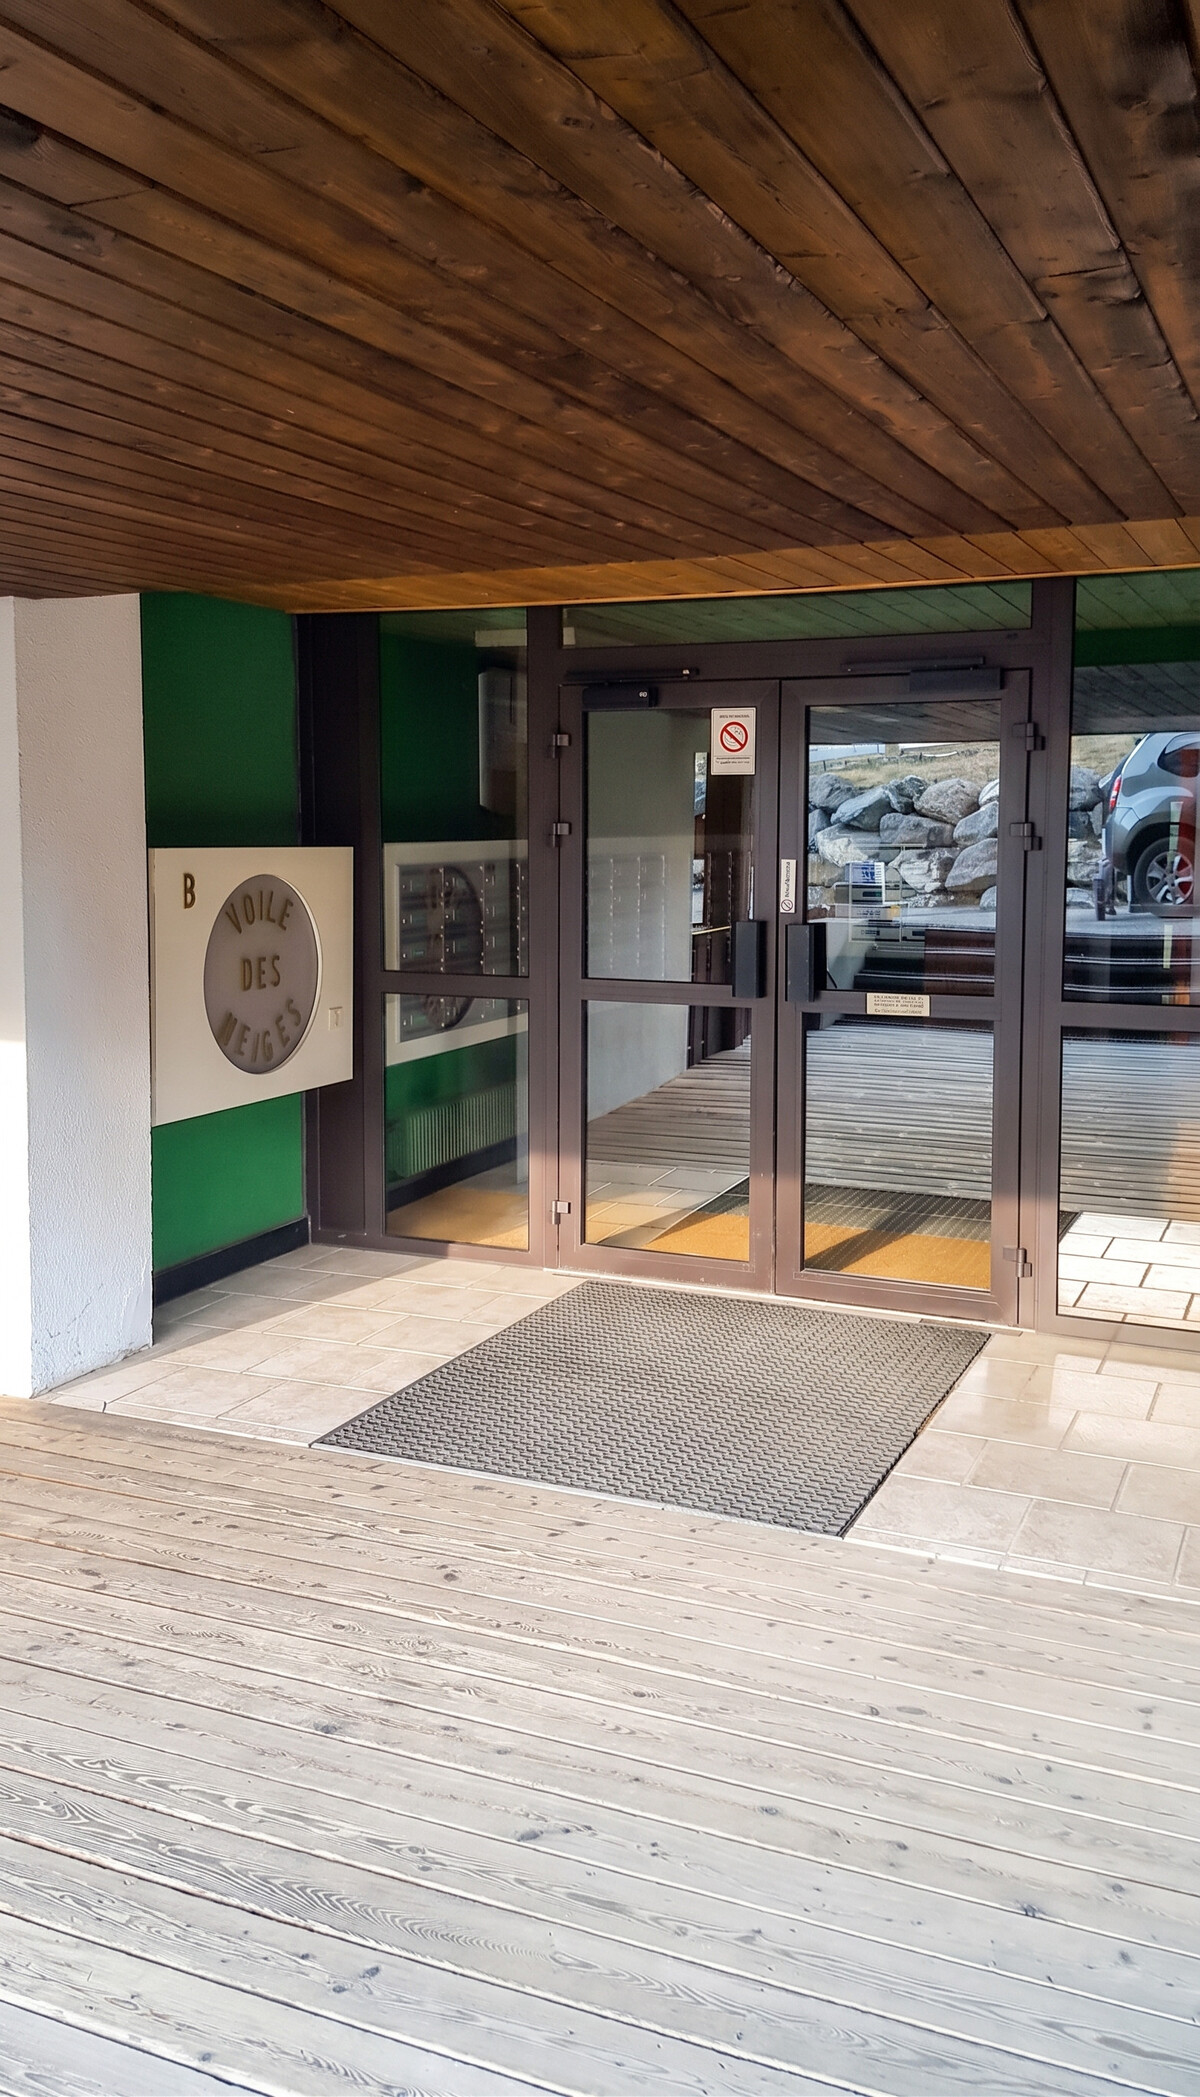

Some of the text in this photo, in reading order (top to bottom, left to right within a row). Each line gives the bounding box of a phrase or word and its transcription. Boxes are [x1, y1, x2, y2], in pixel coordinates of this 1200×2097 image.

[183, 873, 196, 909] B
[225, 890, 294, 934] VOILE
[240, 954, 281, 992] DES
